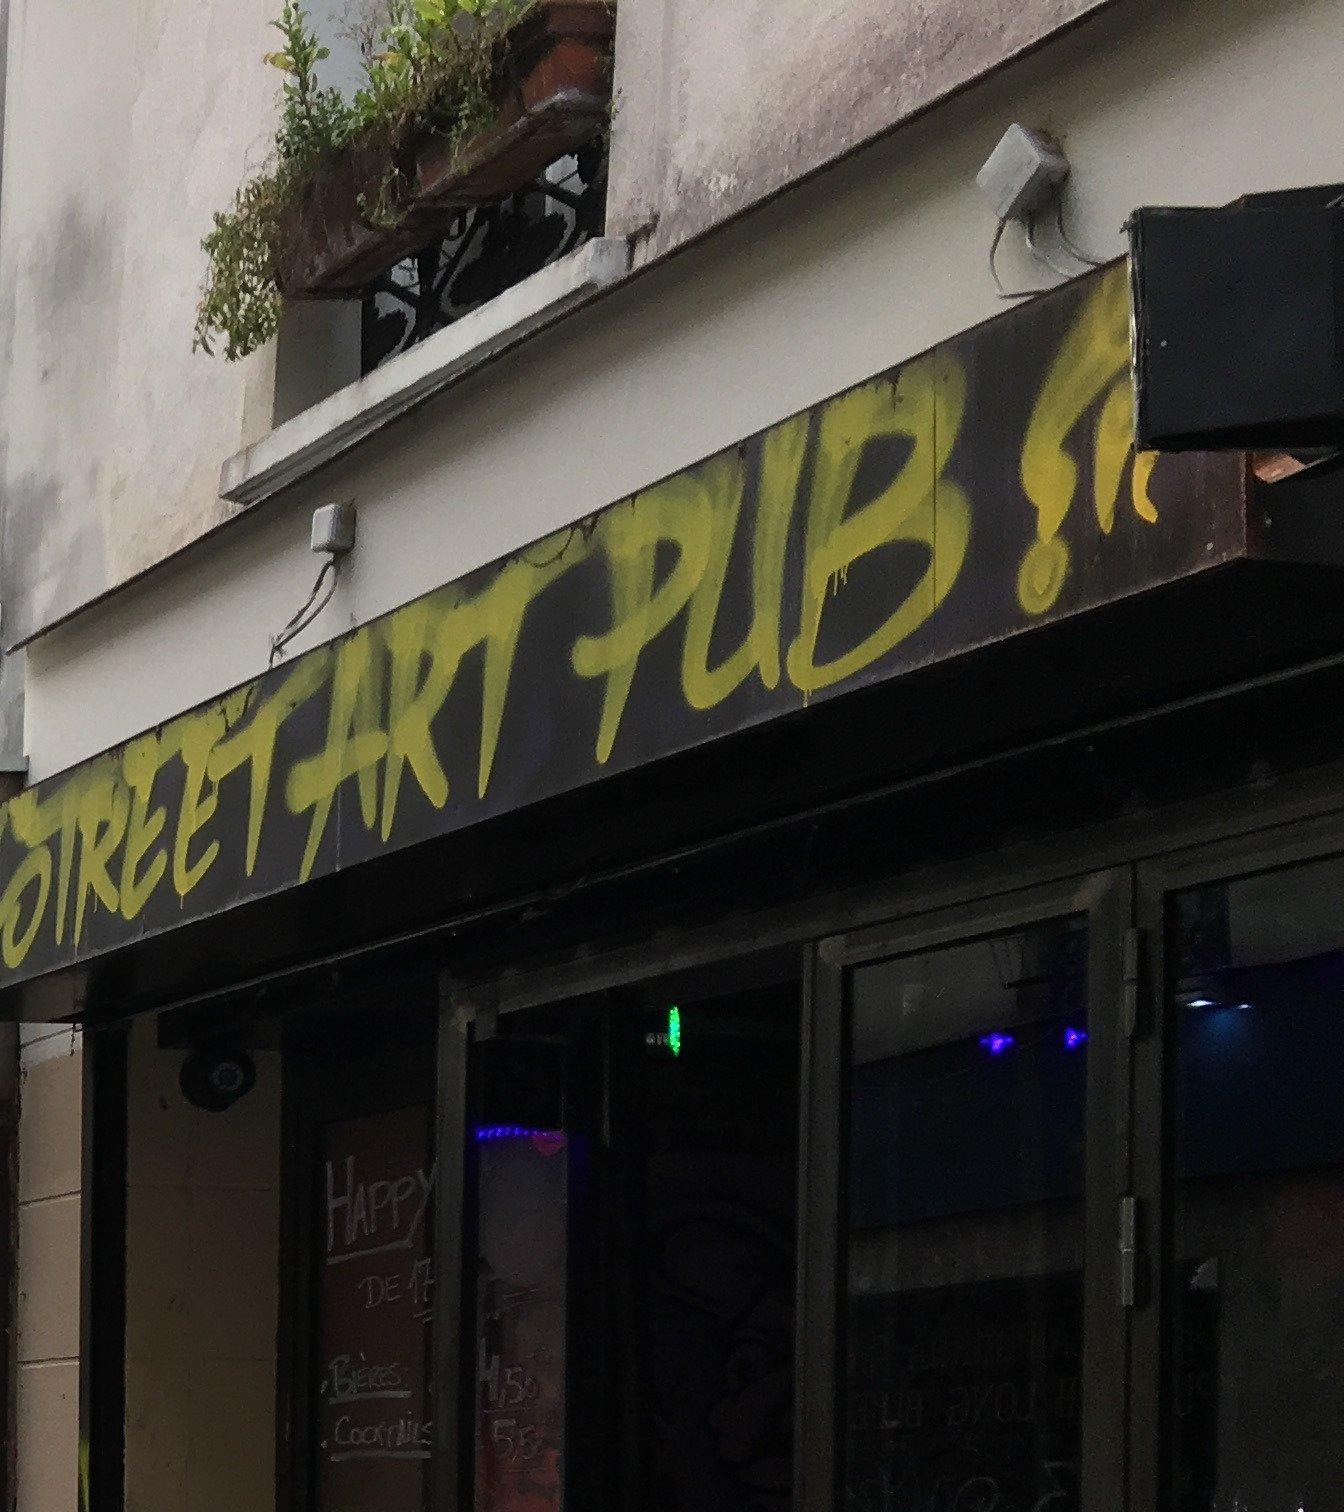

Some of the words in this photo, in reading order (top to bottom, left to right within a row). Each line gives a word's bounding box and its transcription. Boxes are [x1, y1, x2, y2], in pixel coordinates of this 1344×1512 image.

[285, 530, 597, 885] ART
[570, 345, 972, 766] PUB
[357, 1274, 401, 1309] DE
